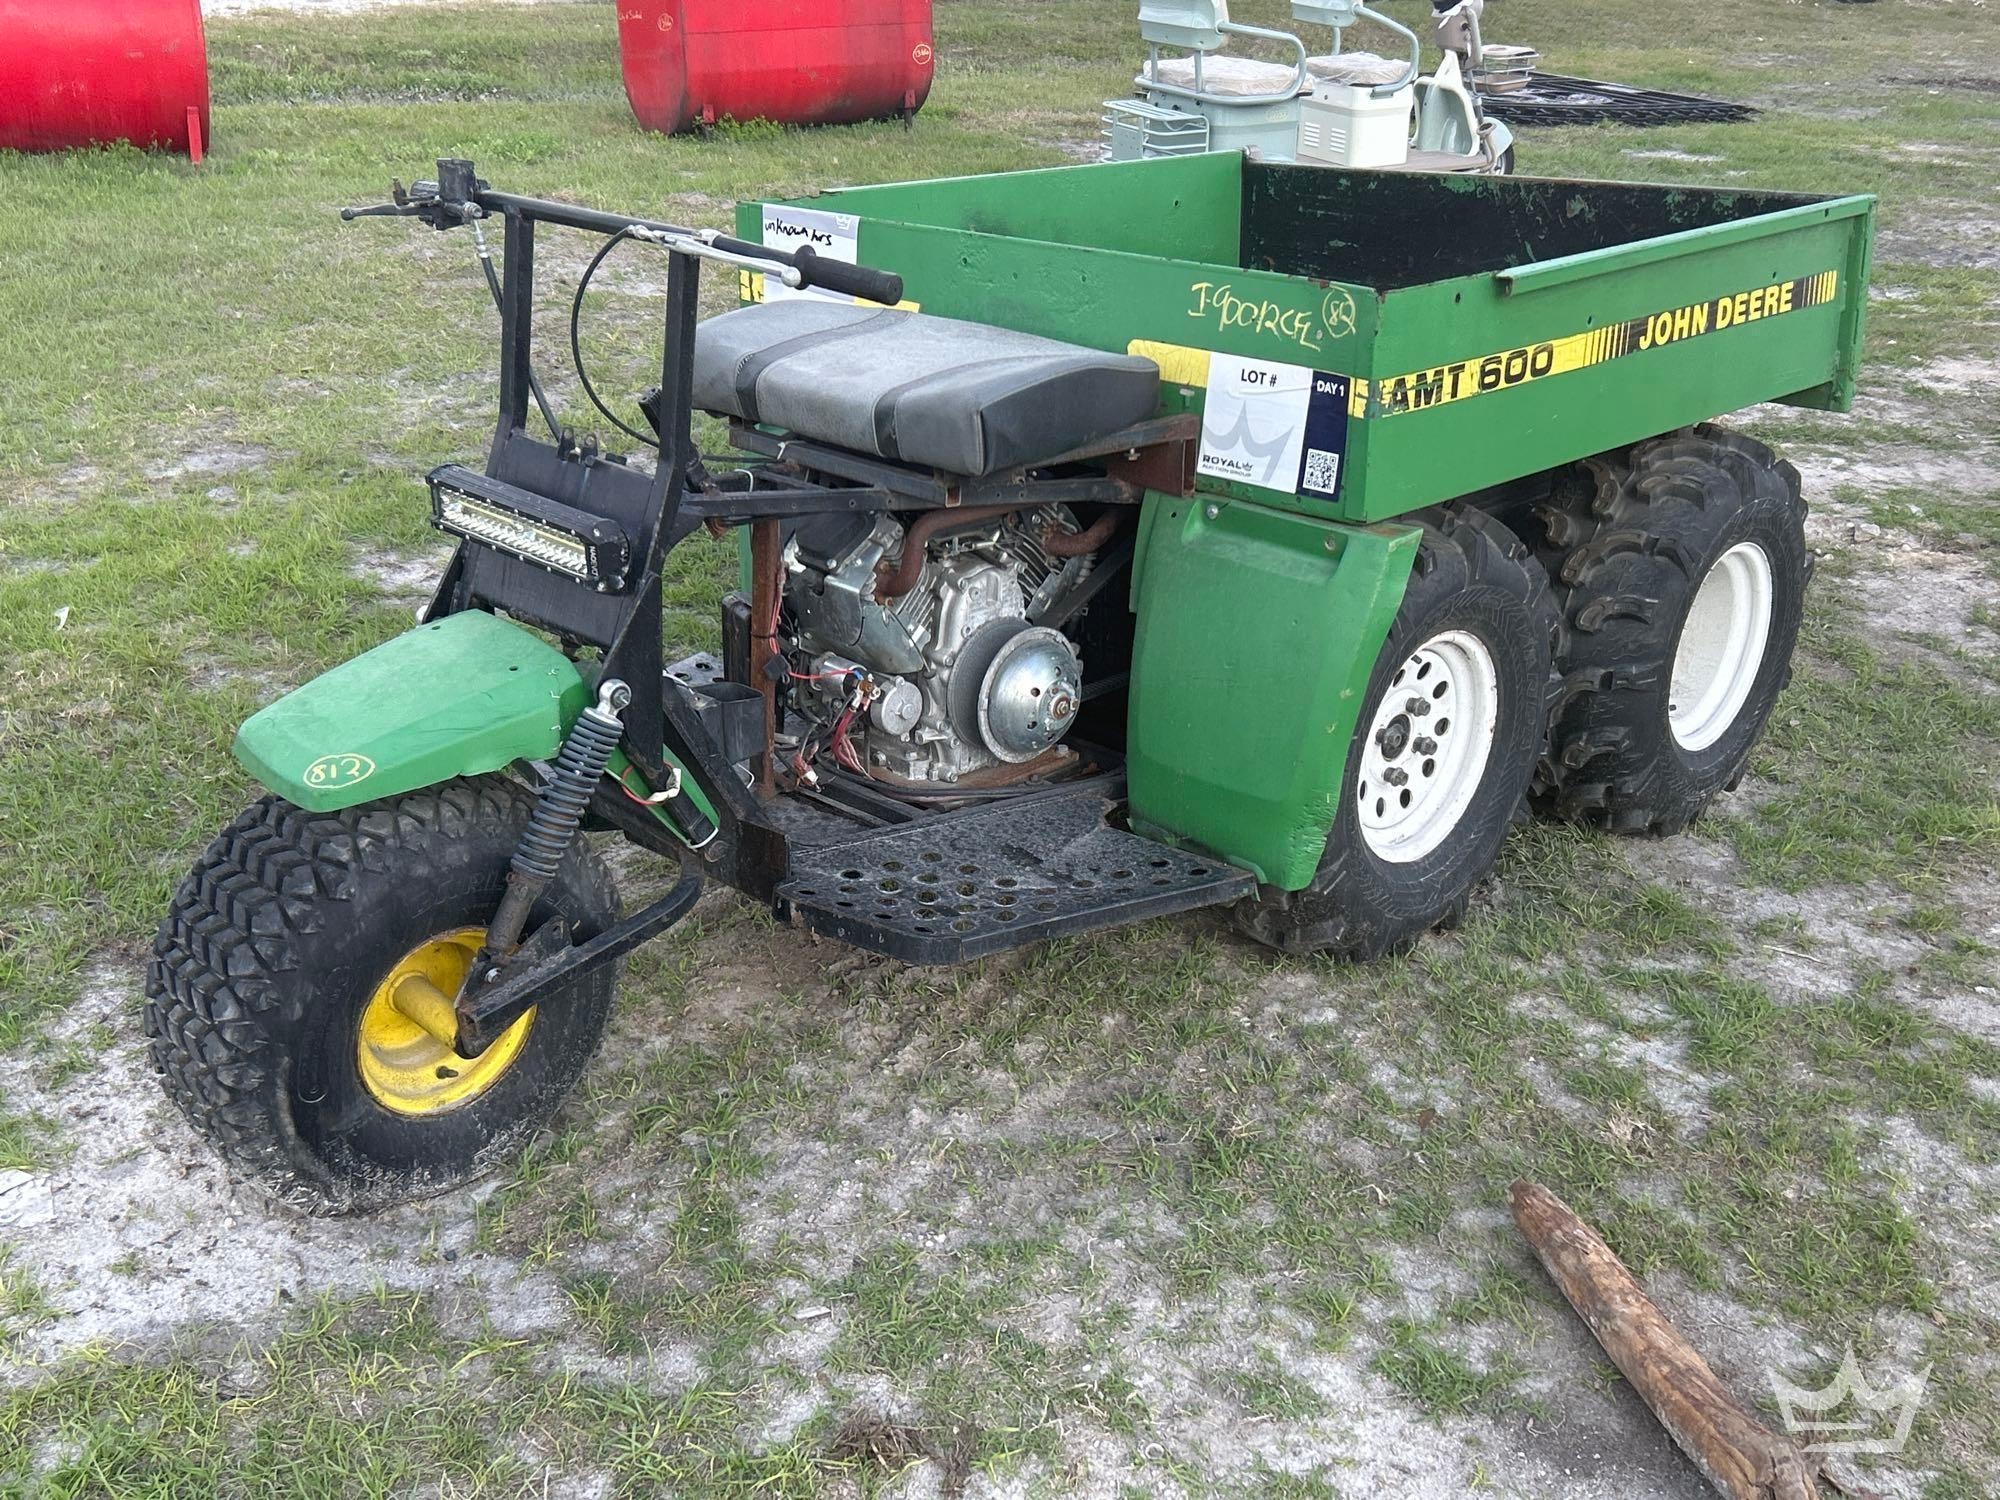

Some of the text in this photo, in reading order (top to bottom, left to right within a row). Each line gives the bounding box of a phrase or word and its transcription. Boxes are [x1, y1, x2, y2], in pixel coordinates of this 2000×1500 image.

[810, 228, 833, 246] hrs
[1639, 281, 1794, 350] JOHN DEERE
[1241, 368, 1278, 388] LOT #
[1387, 342, 1554, 412] AMT 600
[1316, 380, 1345, 397] DAY 1
[1202, 454, 1242, 470] ROYAL
[309, 756, 362, 784] 812
